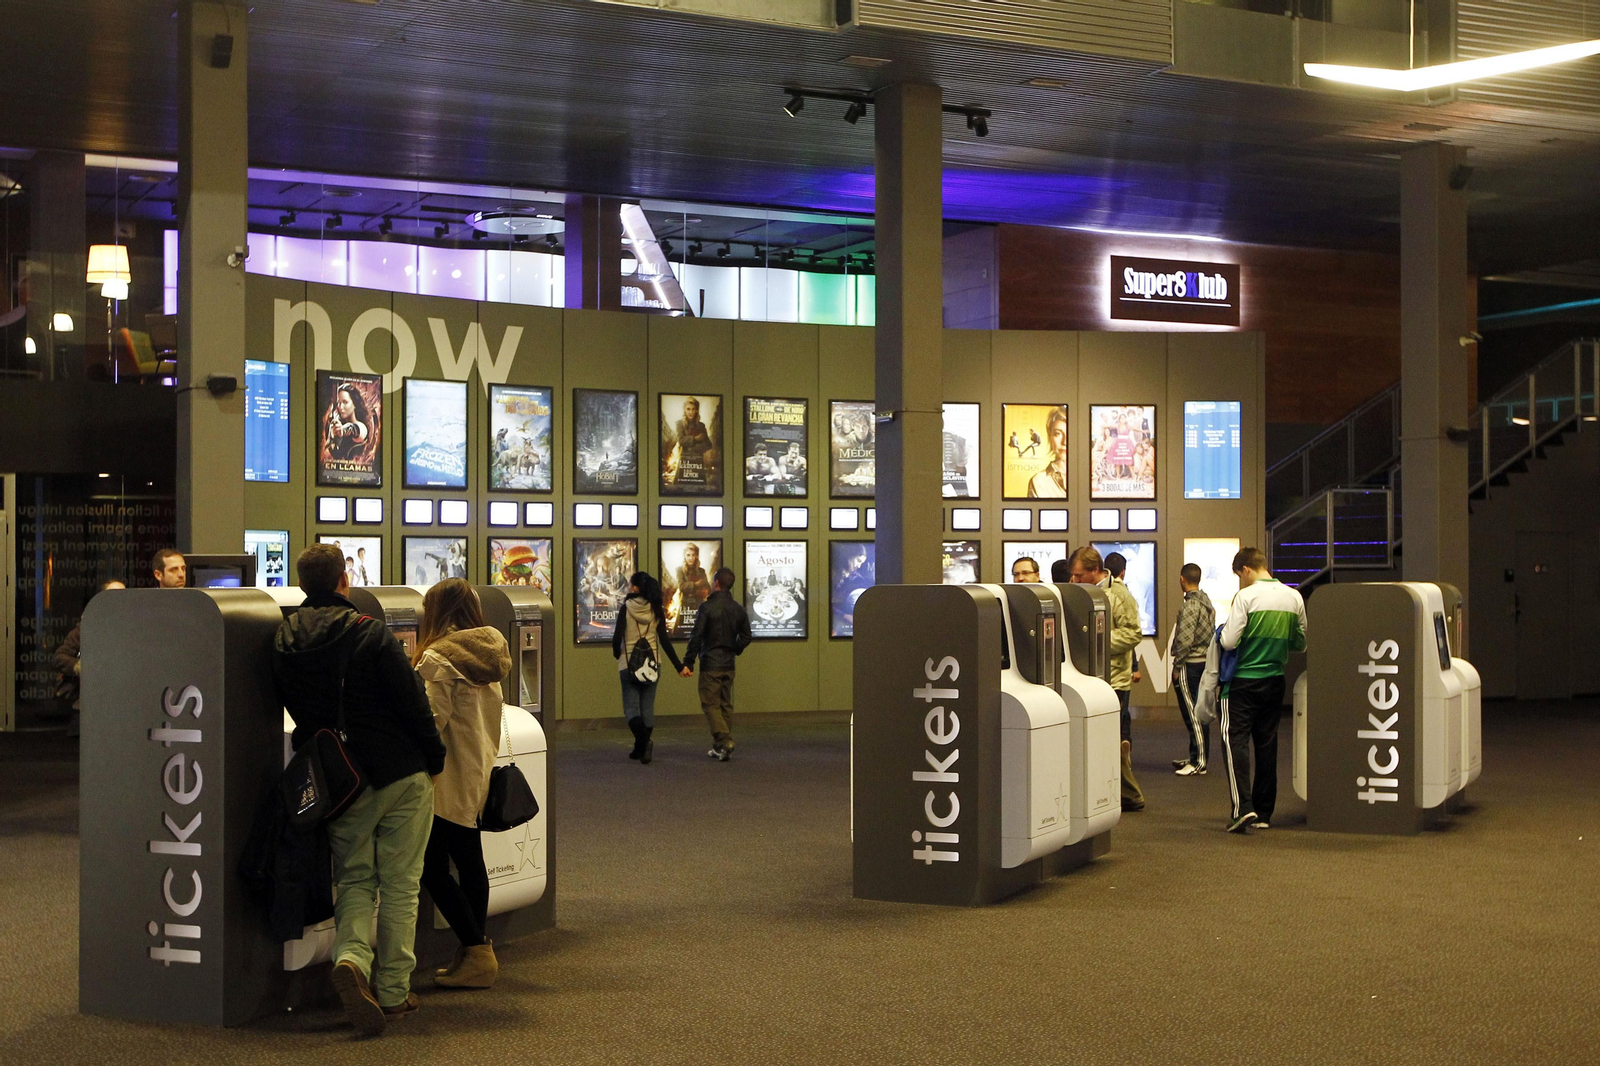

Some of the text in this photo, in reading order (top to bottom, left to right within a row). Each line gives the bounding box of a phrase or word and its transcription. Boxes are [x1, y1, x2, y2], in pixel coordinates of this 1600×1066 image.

[1124, 267, 1227, 300] Super8Klub
[273, 298, 524, 398] now
[750, 412, 758, 421] LA
[758, 412, 774, 422] GRAN
[774, 412, 804, 423] REVANCHA
[340, 464, 372, 472] LLAMAS
[411, 448, 464, 470] FROZEN
[88, 521, 132, 536] image
[758, 555, 794, 567] Agosto
[1356, 638, 1400, 804] tickets
[912, 655, 960, 865] tickets
[150, 684, 203, 967] tickets
[496, 864, 514, 873] Ticketing
